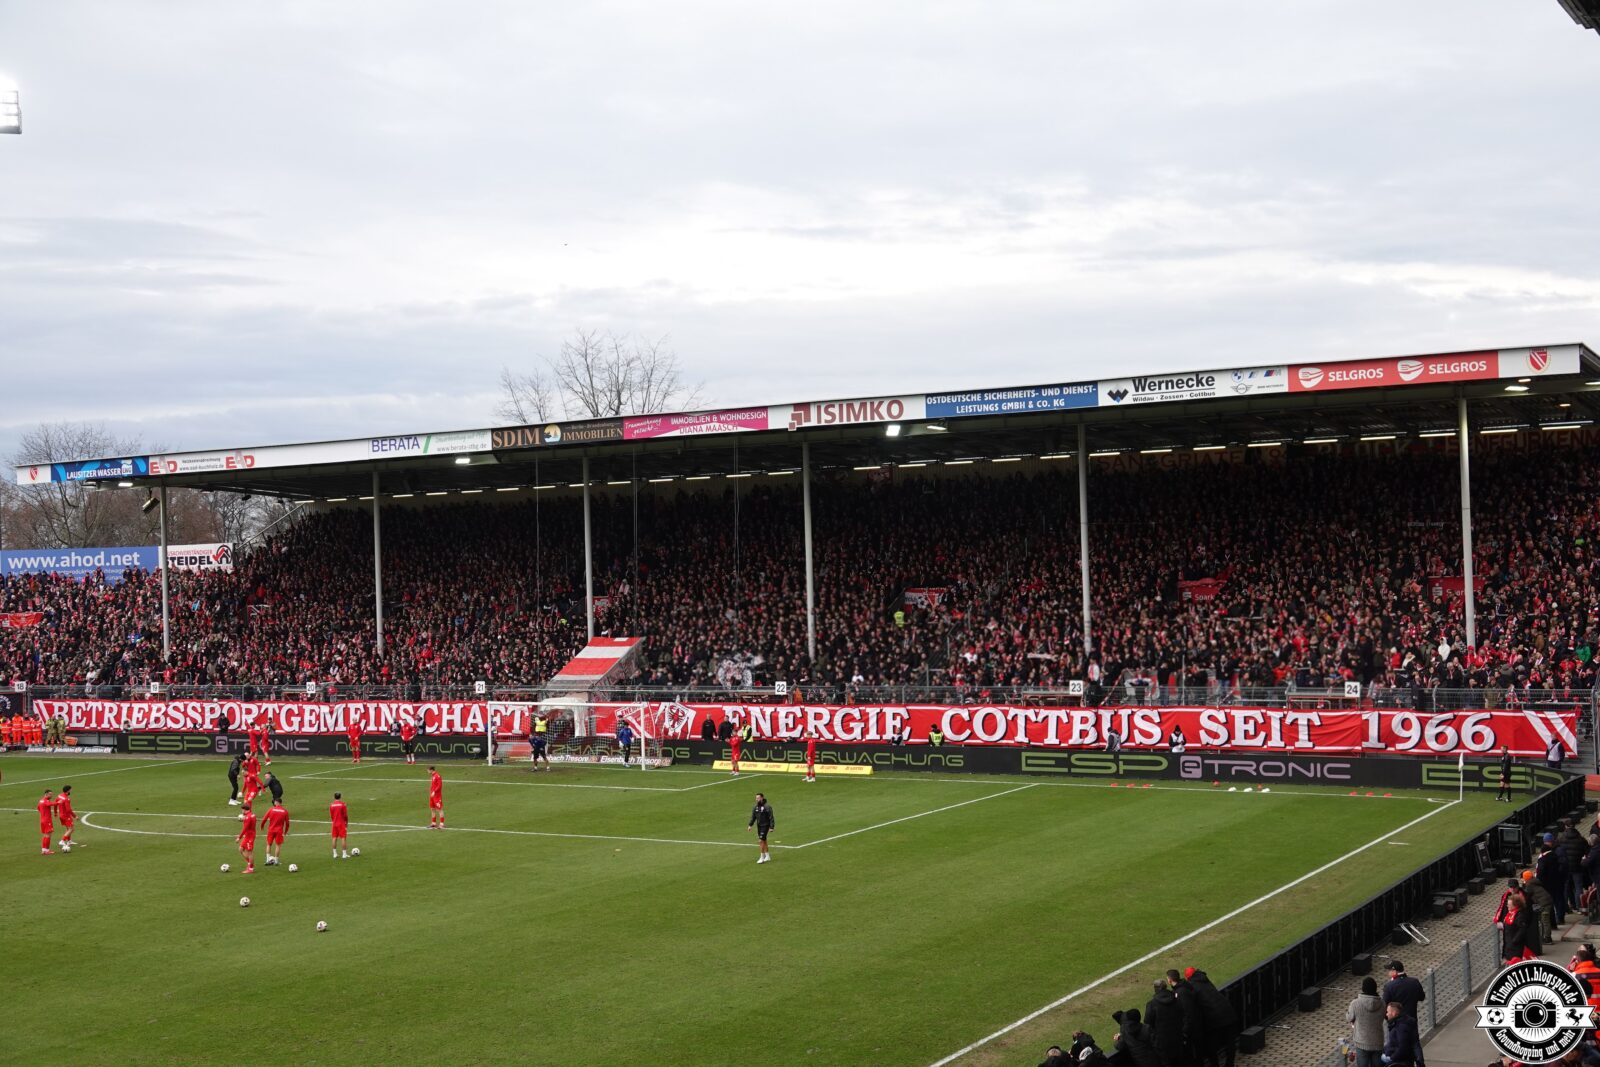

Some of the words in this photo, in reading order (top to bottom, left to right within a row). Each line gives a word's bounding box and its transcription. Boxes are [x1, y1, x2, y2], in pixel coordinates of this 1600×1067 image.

[1328, 368, 1384, 382] SELGROS
[1428, 360, 1487, 375] SELGROS
[1132, 373, 1216, 392] Wernecke
[927, 394, 981, 404] OSTDEUTSCHE
[984, 390, 1039, 401] SICHERHEITS-
[1041, 387, 1060, 397] UND
[1063, 384, 1097, 395] DIENST-
[1132, 395, 1155, 403] Wildau
[1160, 394, 1184, 402] Zossen
[1189, 391, 1216, 399] Cottbus
[816, 400, 904, 425] ISIMKO
[957, 402, 999, 413] LEISTUNGS
[1001, 400, 1026, 410] GMBH
[1028, 399, 1034, 408] &
[1036, 399, 1050, 408] CO.
[1053, 398, 1065, 407] KG
[671, 415, 711, 425] IMMOBILIEN
[719, 410, 767, 421] WOHNDESIGN
[562, 428, 623, 441] IMMOBILIEN
[680, 424, 705, 434] DIANA
[706, 421, 739, 433] MAASCH
[371, 436, 420, 452] BERATA
[492, 428, 540, 449] SDIM
[66, 469, 97, 480] LAUSITZER
[97, 466, 122, 477] WASSER
[8, 551, 140, 569] www.ahod.net
[306, 684, 315, 692] 20
[476, 683, 485, 692] 21
[776, 683, 786, 693] 22
[1071, 682, 1082, 692] 23
[1346, 684, 1358, 695] 24
[722, 705, 911, 742] ENERGIE
[941, 707, 1162, 746] COTTBUS
[1200, 708, 1321, 748] SEIT
[1361, 710, 1495, 752] 1966
[128, 735, 211, 751] ESP
[1021, 751, 1169, 775] ESP
